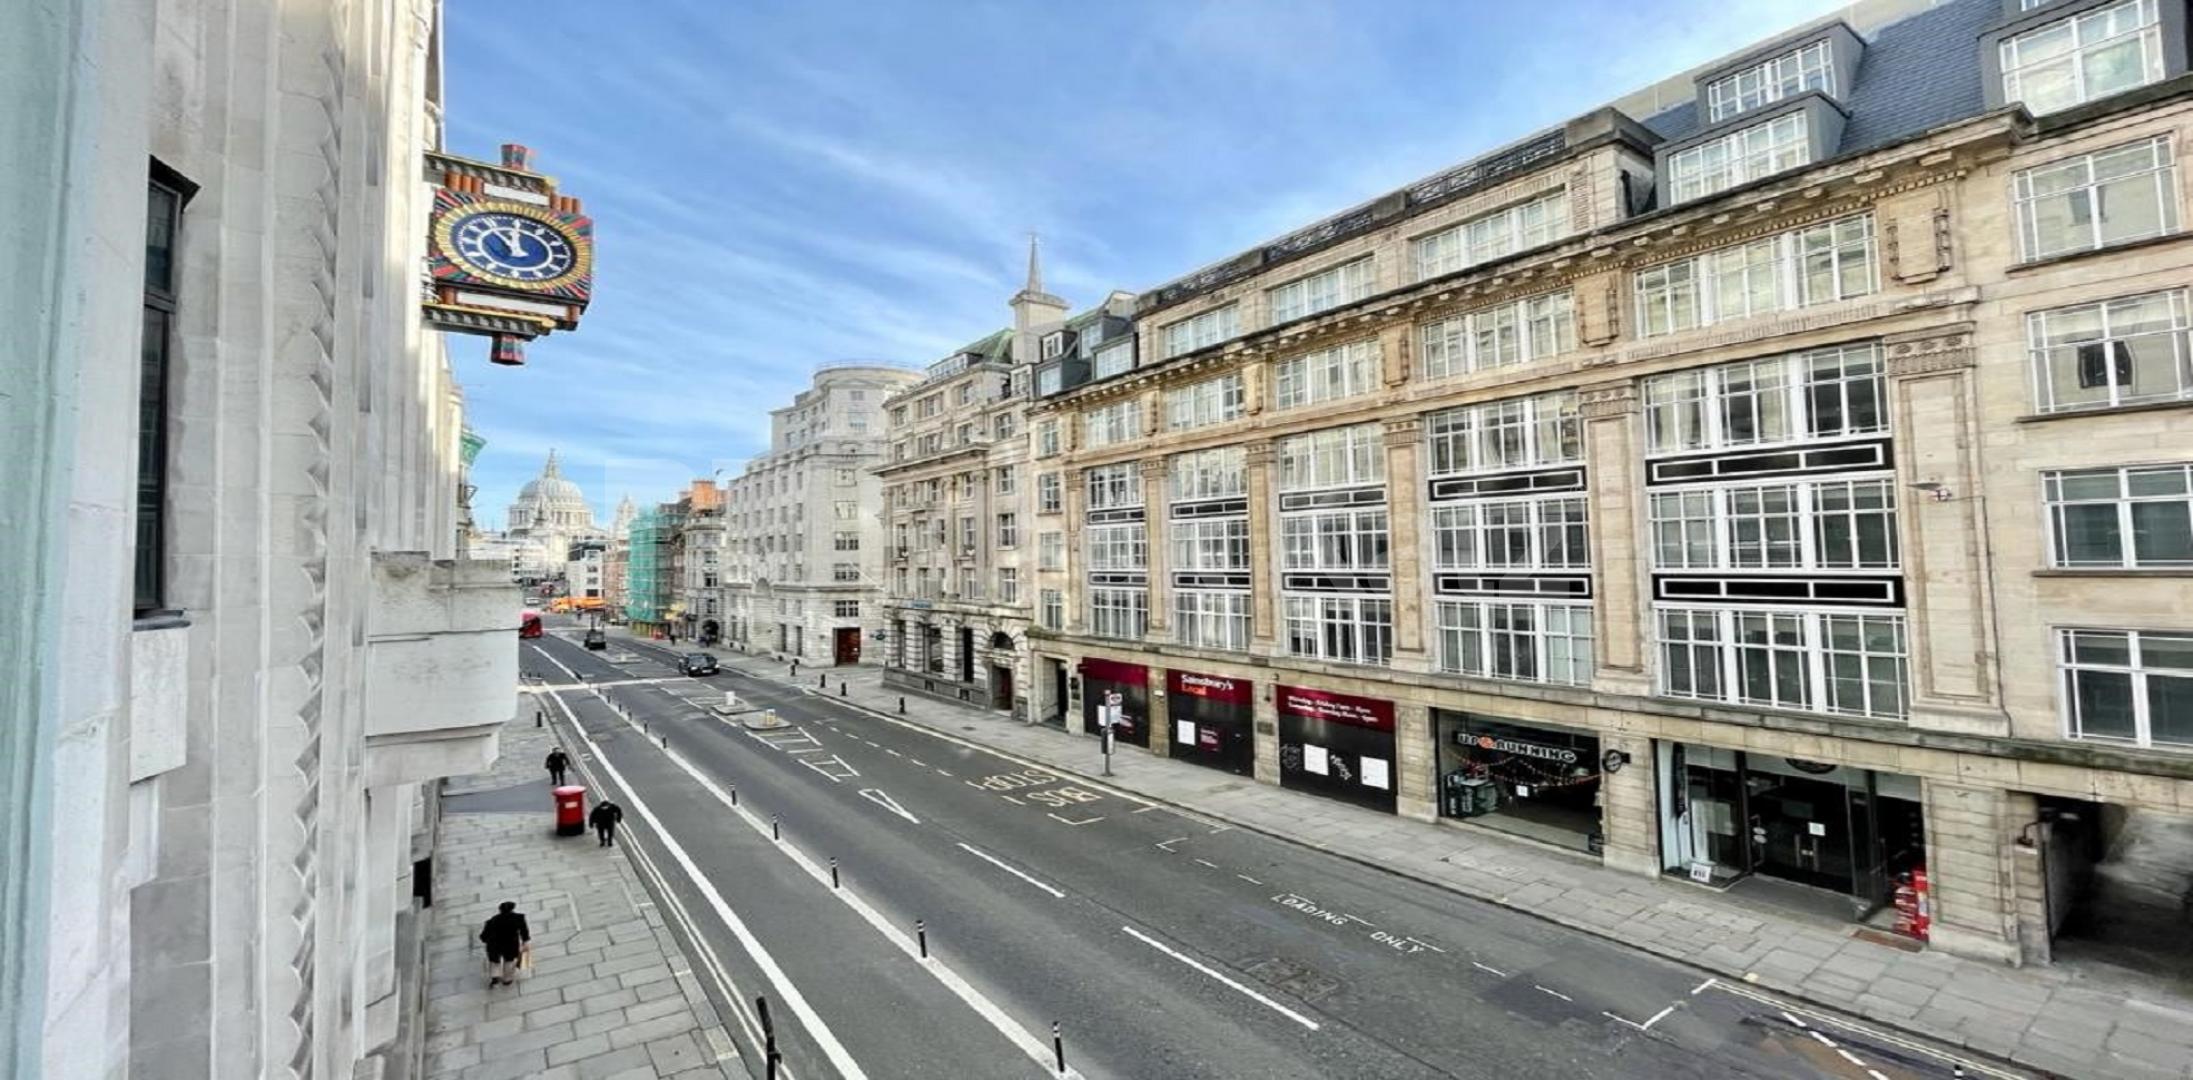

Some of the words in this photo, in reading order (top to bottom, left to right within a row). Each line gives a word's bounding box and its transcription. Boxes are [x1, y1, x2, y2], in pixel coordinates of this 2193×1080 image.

[1181, 674, 1235, 691] Sainsbury's
[1181, 683, 1207, 695] Local
[1027, 786, 1103, 807] BUS
[1270, 893, 1349, 925] LOADING
[1370, 931, 1425, 953] ONLY
